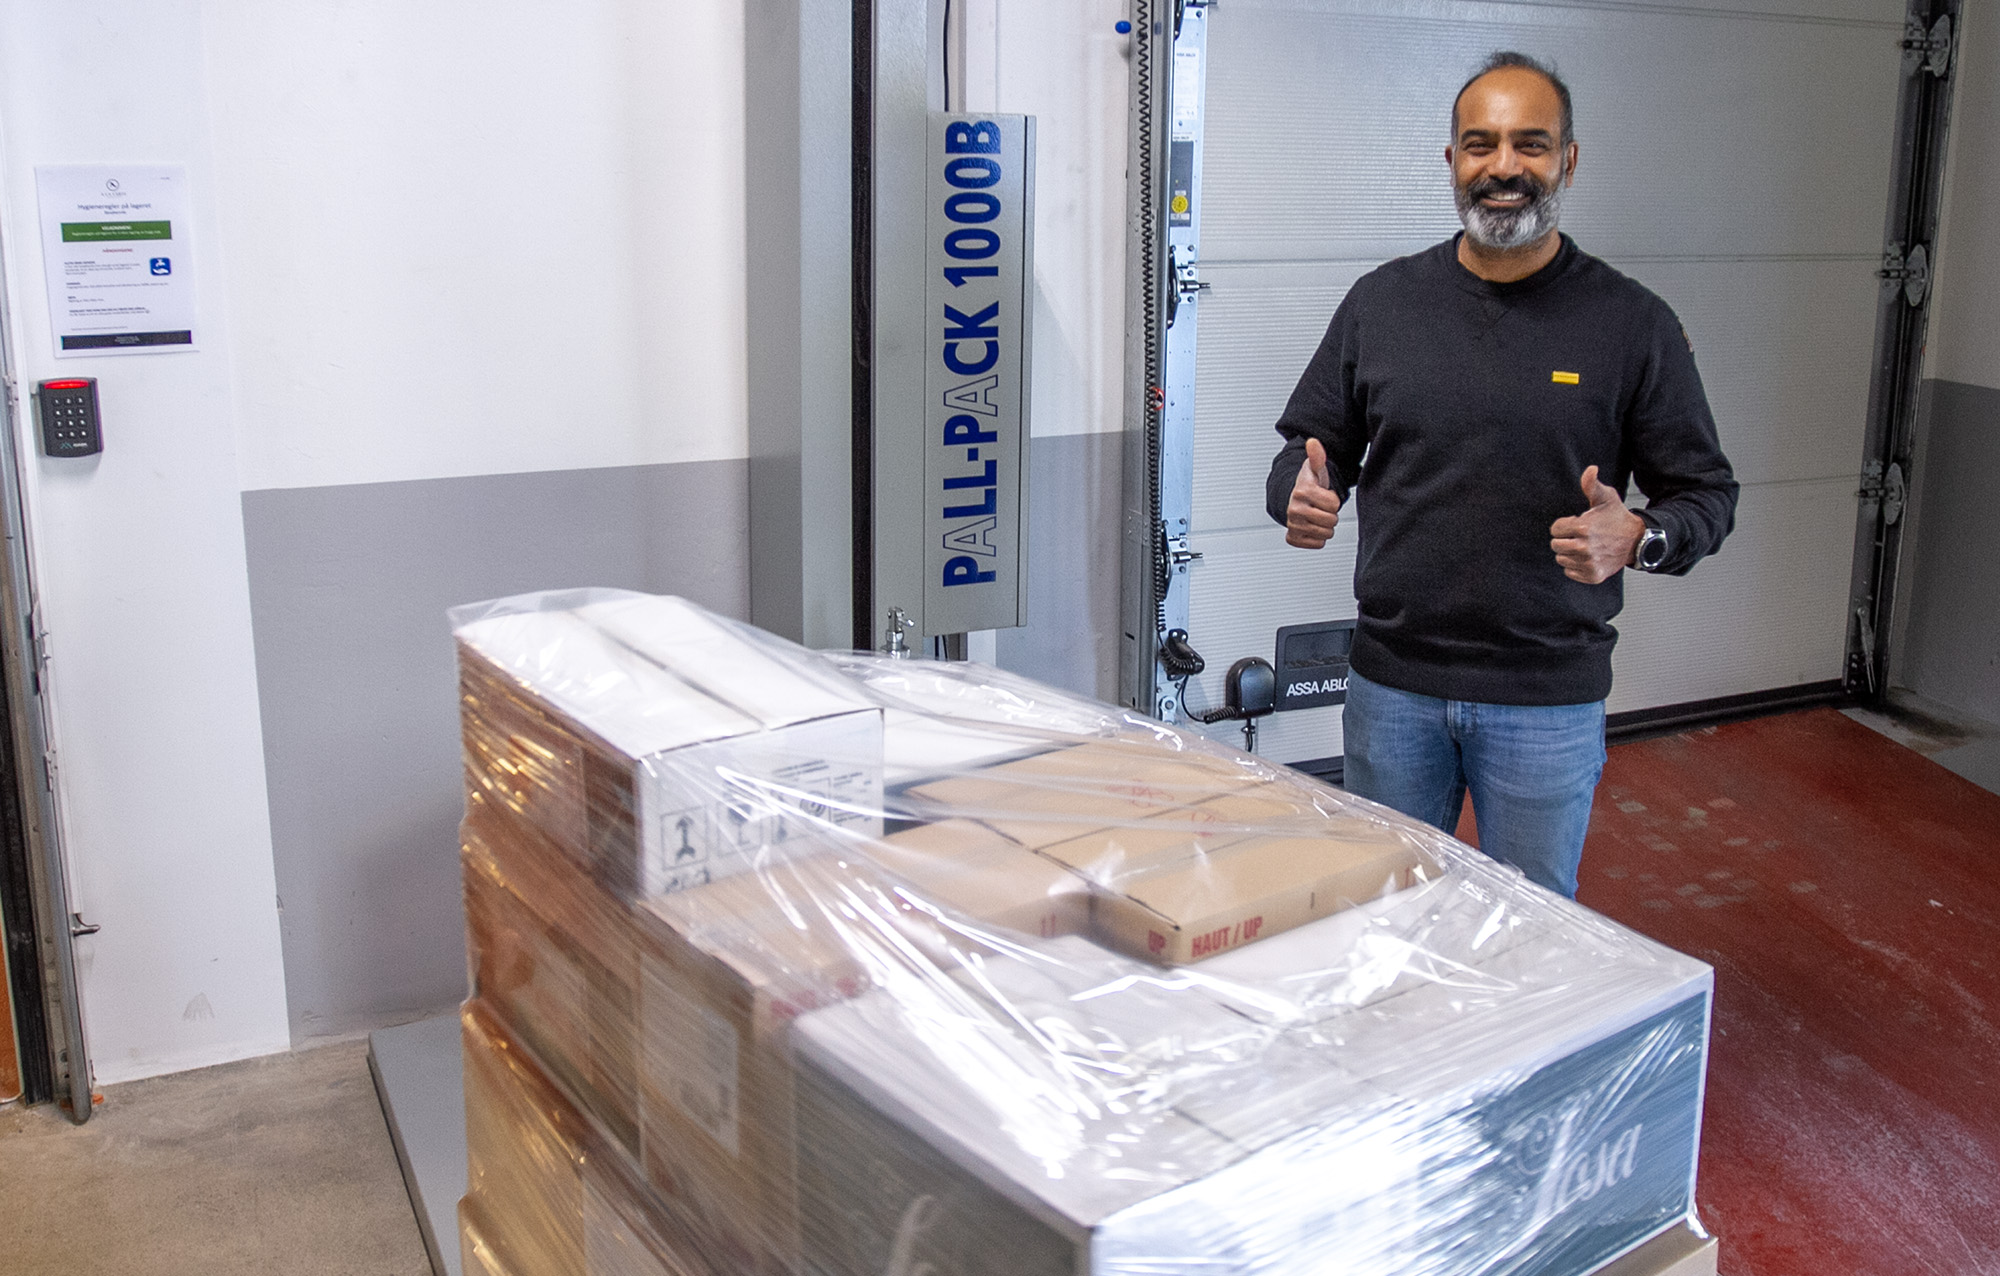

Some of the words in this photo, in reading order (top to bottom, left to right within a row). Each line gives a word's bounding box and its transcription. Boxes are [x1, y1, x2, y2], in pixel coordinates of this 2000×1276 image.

[943, 119, 1002, 289] 1000B
[942, 301, 999, 588] PALL-PACK
[1286, 681, 1320, 697] ASSA
[1191, 926, 1231, 958] HAUT
[1243, 915, 1263, 941] UP
